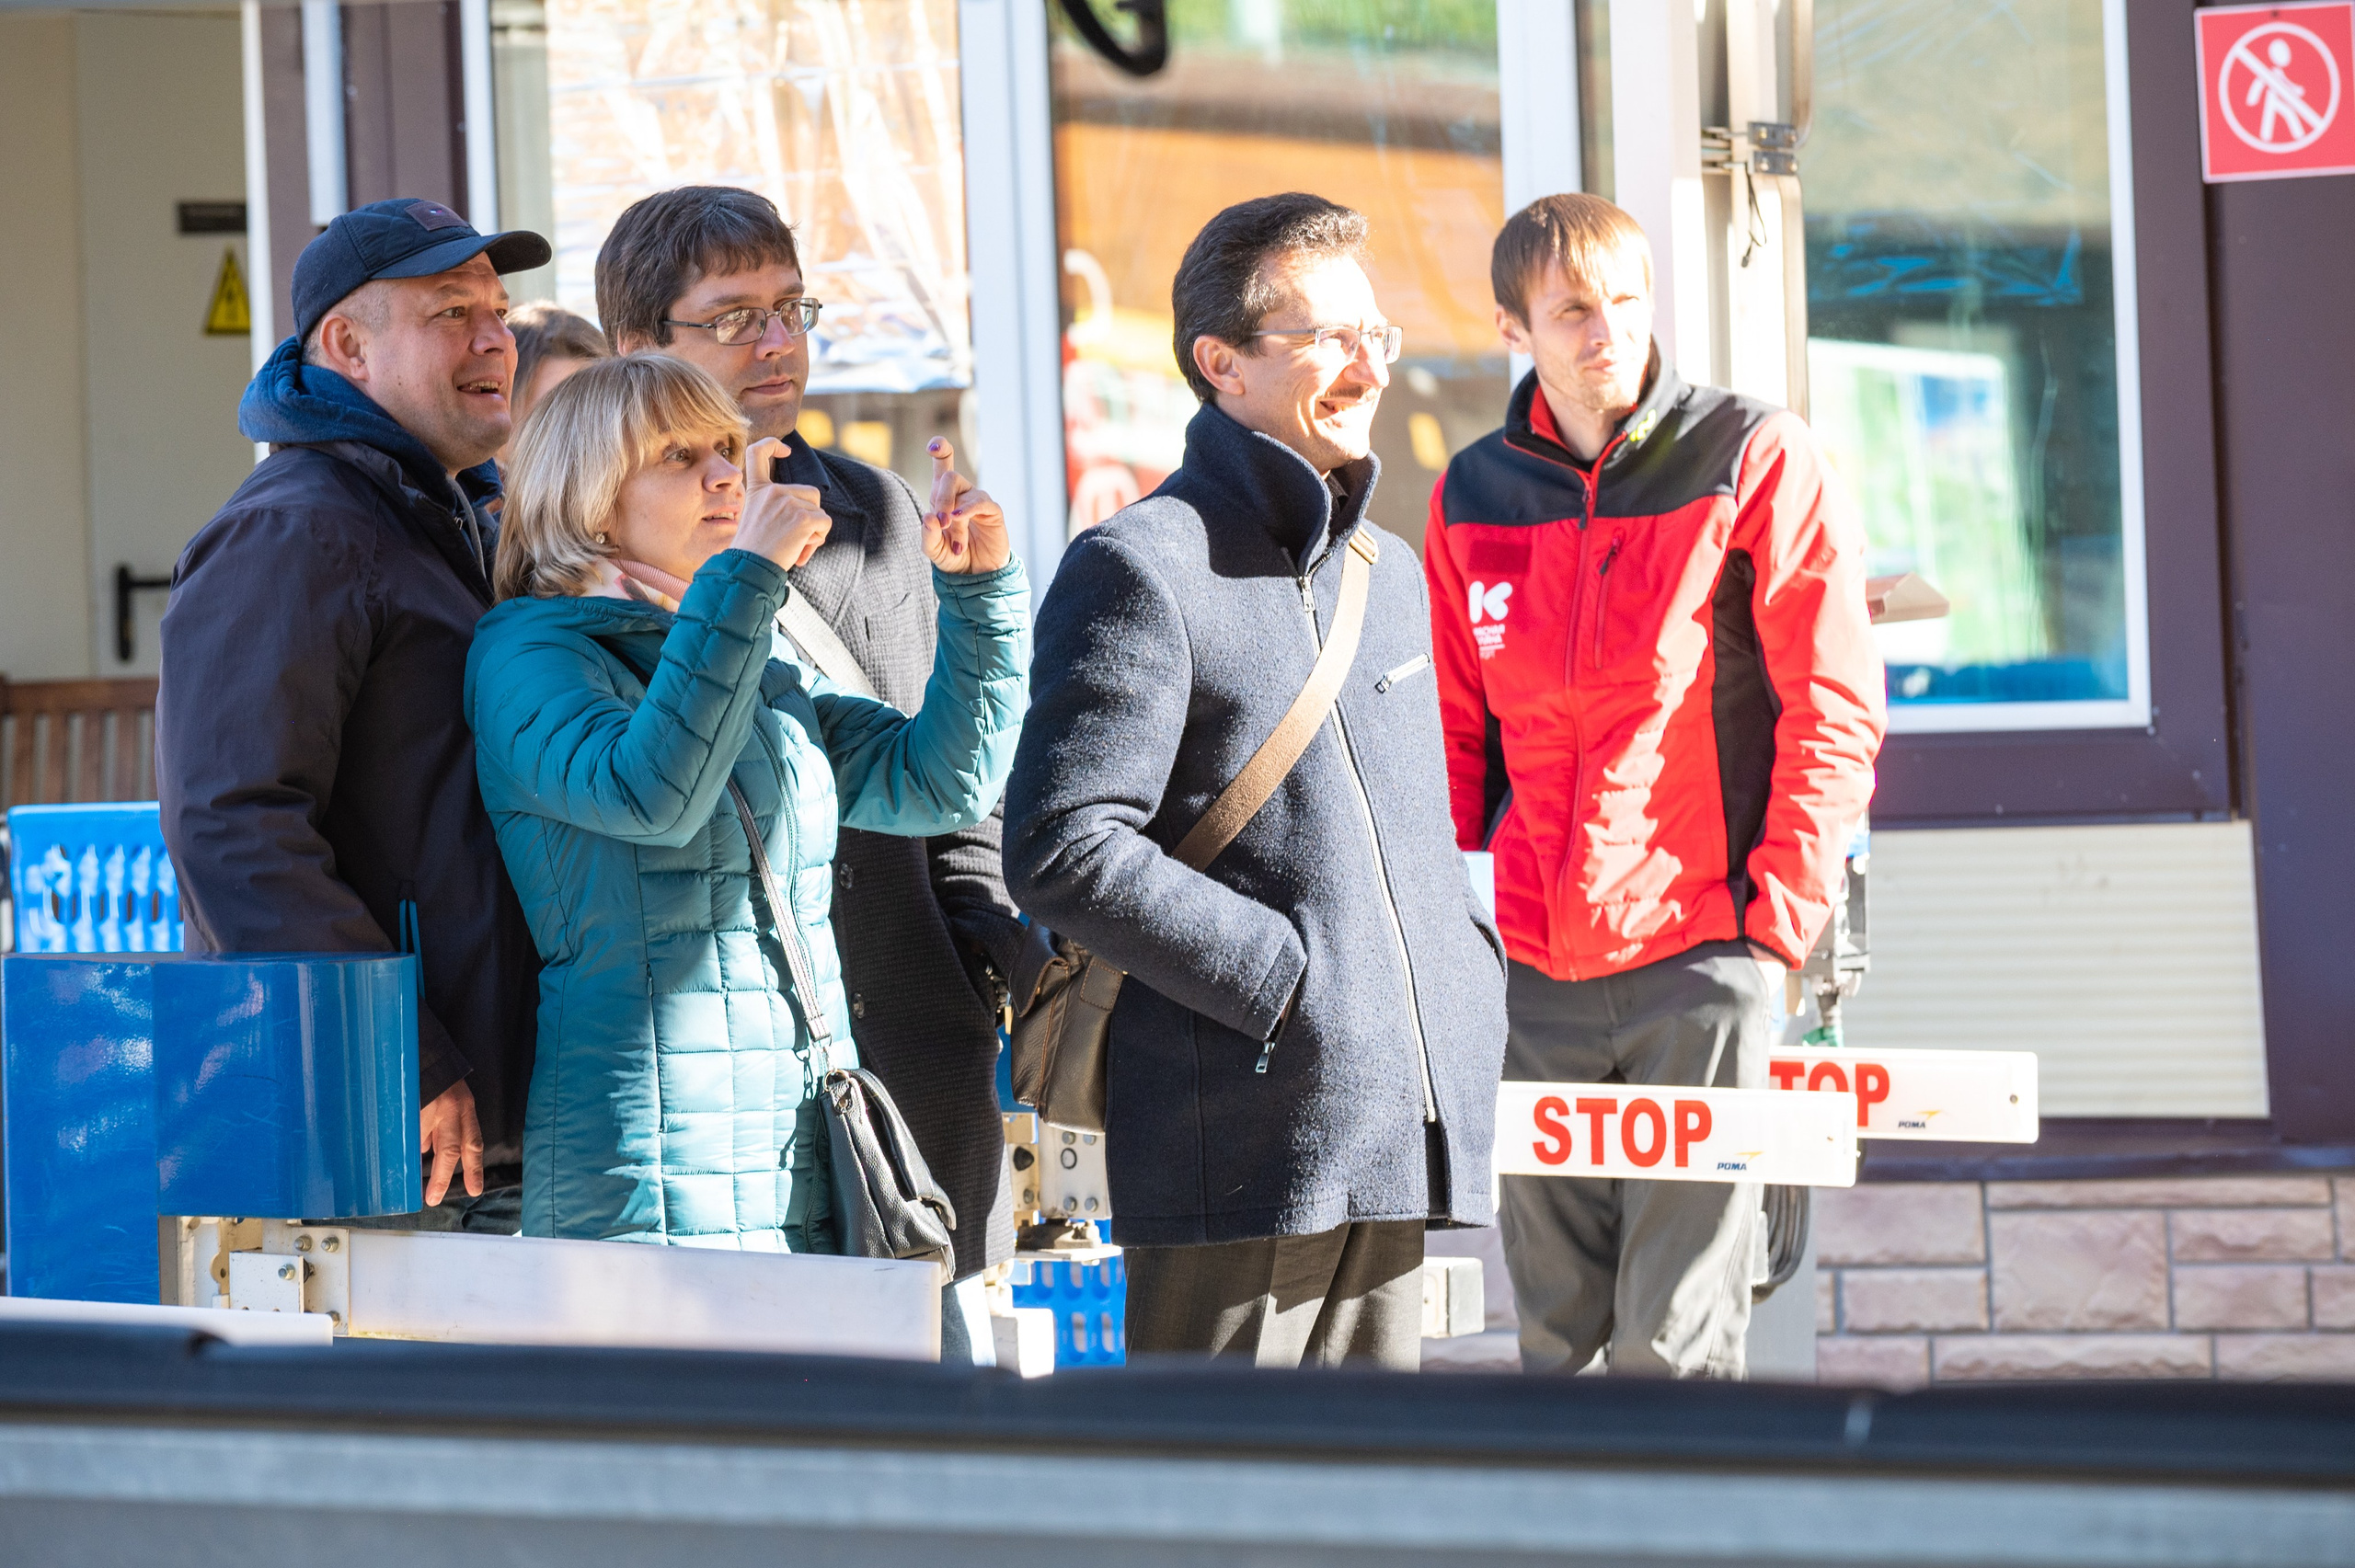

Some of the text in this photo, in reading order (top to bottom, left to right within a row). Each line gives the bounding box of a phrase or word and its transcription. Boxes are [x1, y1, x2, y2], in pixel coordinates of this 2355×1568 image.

[1769, 1060, 1890, 1127] TP
[1533, 1096, 1713, 1168] STOP
[1898, 1120, 1925, 1128] POMA
[1717, 1162, 1747, 1171] POMA
